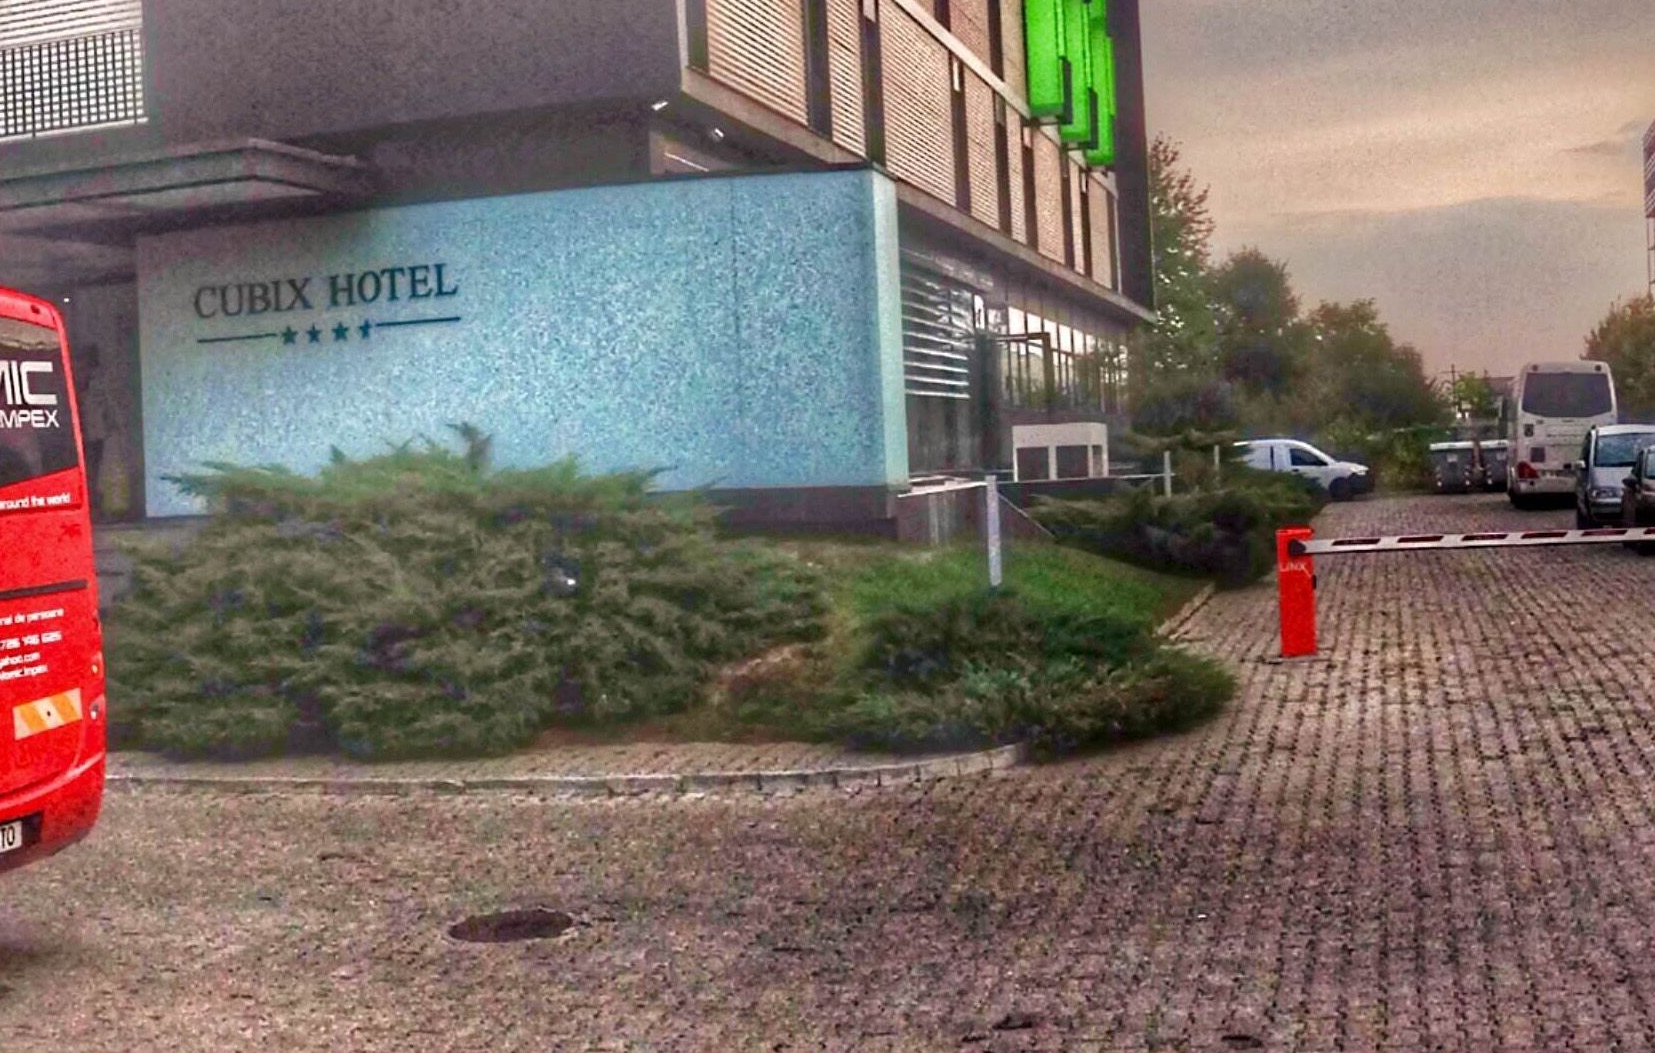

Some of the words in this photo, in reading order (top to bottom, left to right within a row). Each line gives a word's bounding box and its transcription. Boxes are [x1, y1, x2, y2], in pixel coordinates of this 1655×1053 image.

[193, 277, 314, 320] CUBIX
[326, 261, 459, 308] HOTEL
[31, 495, 45, 507] the
[46, 492, 71, 505] world
